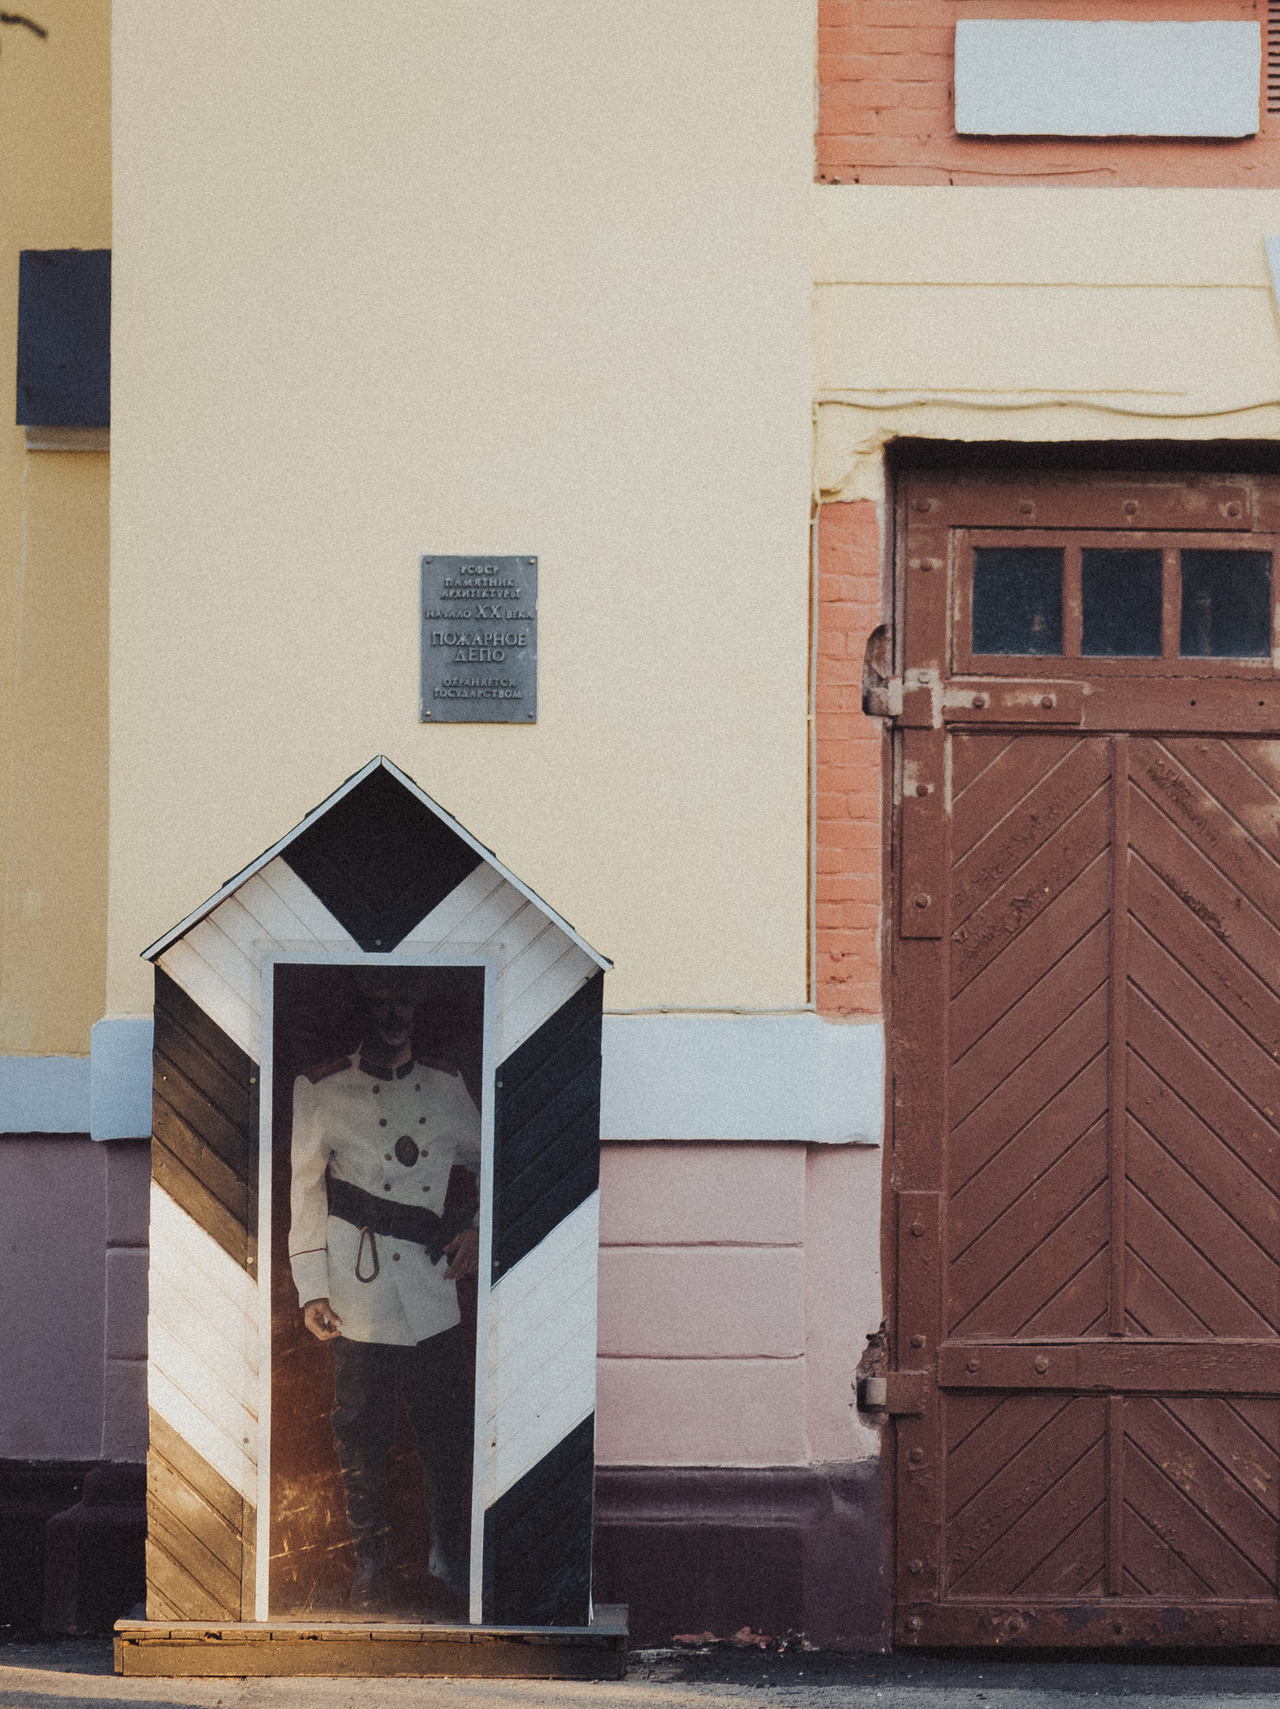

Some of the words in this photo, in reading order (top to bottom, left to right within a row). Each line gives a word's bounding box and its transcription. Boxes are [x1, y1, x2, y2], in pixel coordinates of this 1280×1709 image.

[444, 578, 515, 589] ПАМЯТНИК
[440, 588, 520, 600] АРХИТЕКТУРЫ
[431, 631, 527, 647] ПОЖАРНОЕ
[454, 647, 505, 663] ДЕПО
[442, 677, 517, 688] ОХРАНЯЕТСЯ
[433, 687, 523, 700] ГОСУДАРСТВОМ
